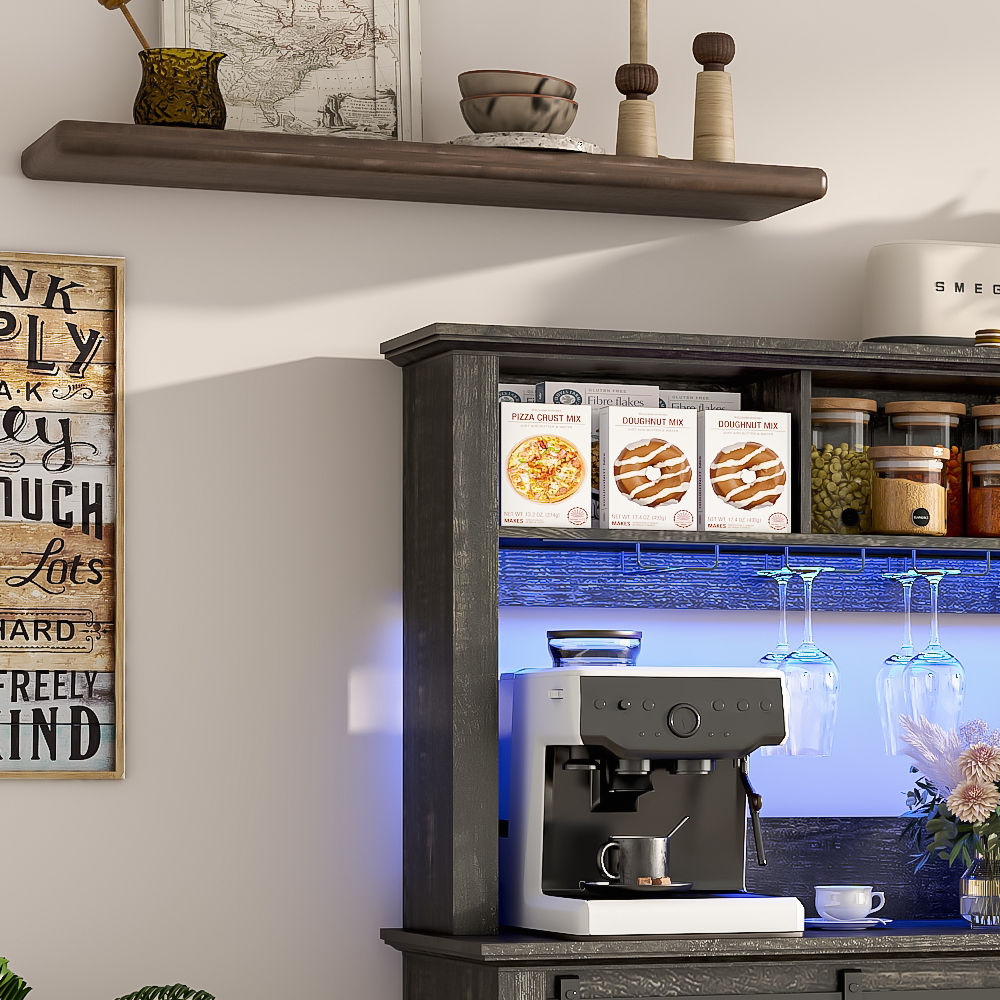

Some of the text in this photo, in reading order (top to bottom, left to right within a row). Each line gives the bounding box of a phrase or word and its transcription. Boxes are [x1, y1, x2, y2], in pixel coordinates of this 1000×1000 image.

[587, 395, 645, 407] Fibre flakes
[511, 413, 582, 423] PIZZA CRUST MIX
[622, 416, 684, 426] DOUGHNUT MIX
[718, 420, 779, 430] DOUGHNUT MIX
[5, 537, 103, 594] Lots
[0, 705, 101, 761] IND
